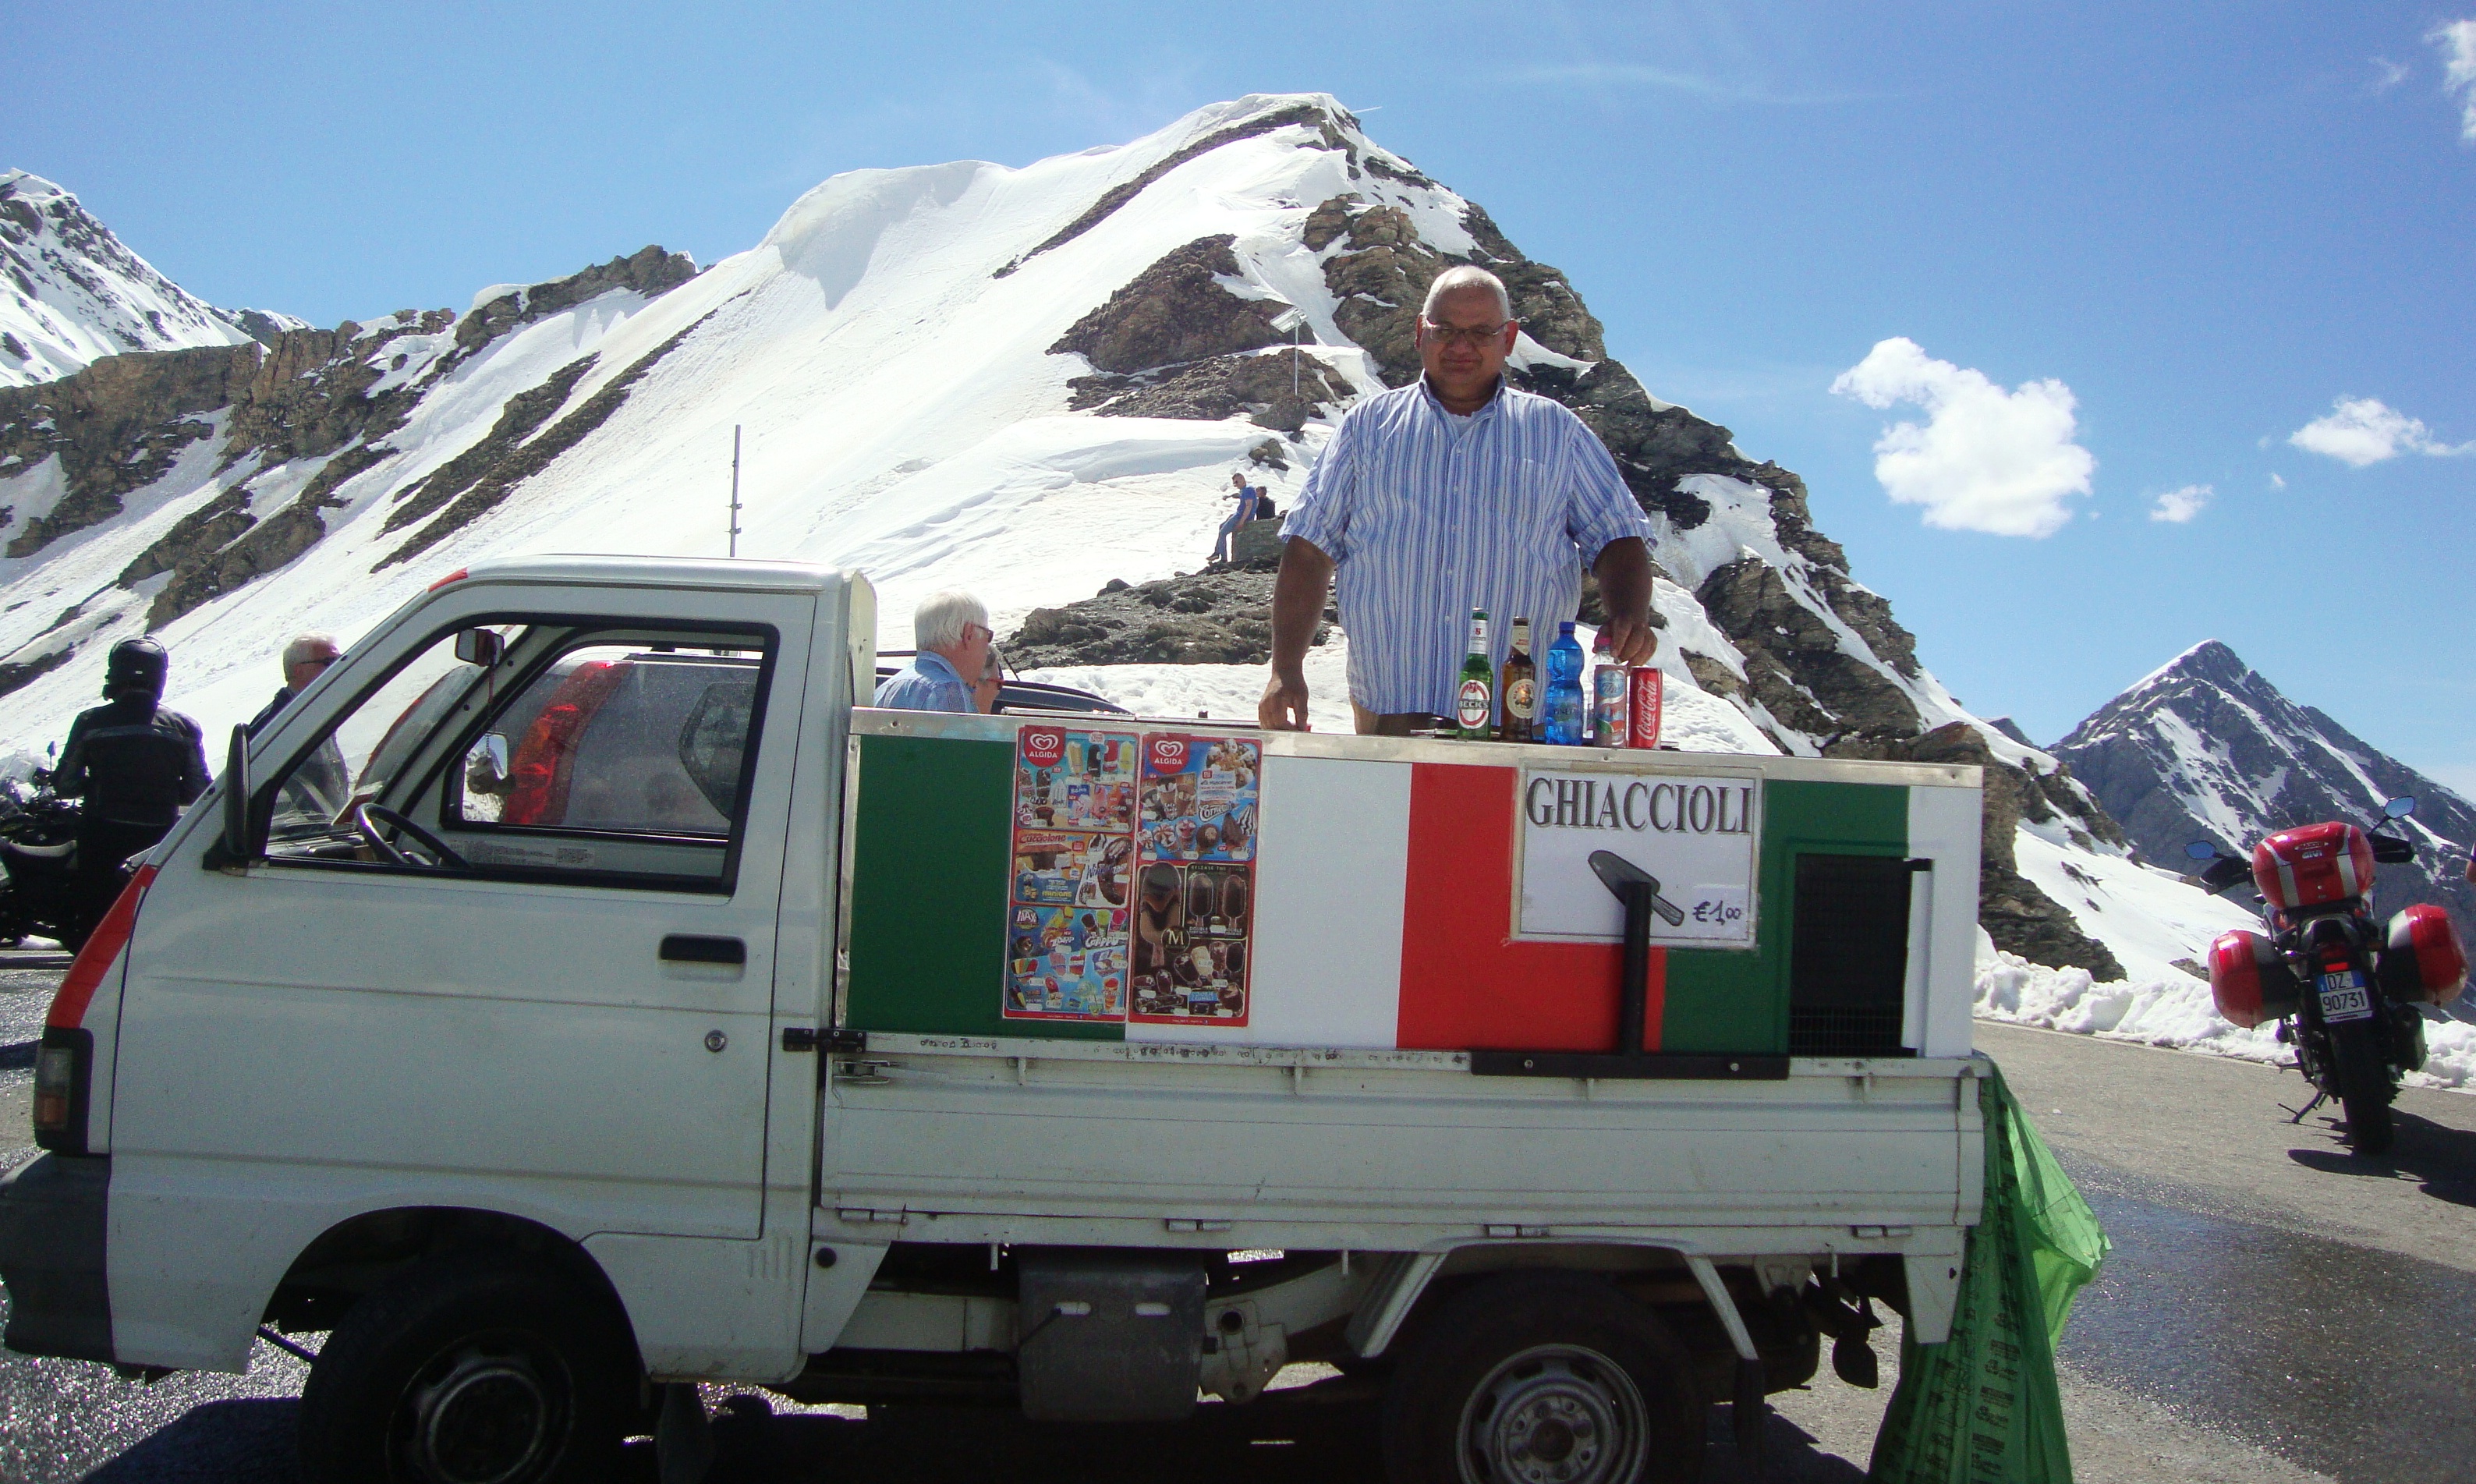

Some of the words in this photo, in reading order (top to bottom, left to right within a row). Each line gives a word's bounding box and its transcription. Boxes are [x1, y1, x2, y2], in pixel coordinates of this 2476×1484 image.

[1029, 750, 1057, 759] ALGIDA
[1526, 777, 1753, 834] GHIACCIOLI
[1016, 910, 1037, 923] MAX
[1168, 930, 1184, 945] M
[2327, 973, 2347, 990] DZ
[2322, 990, 2364, 1011] 90731
